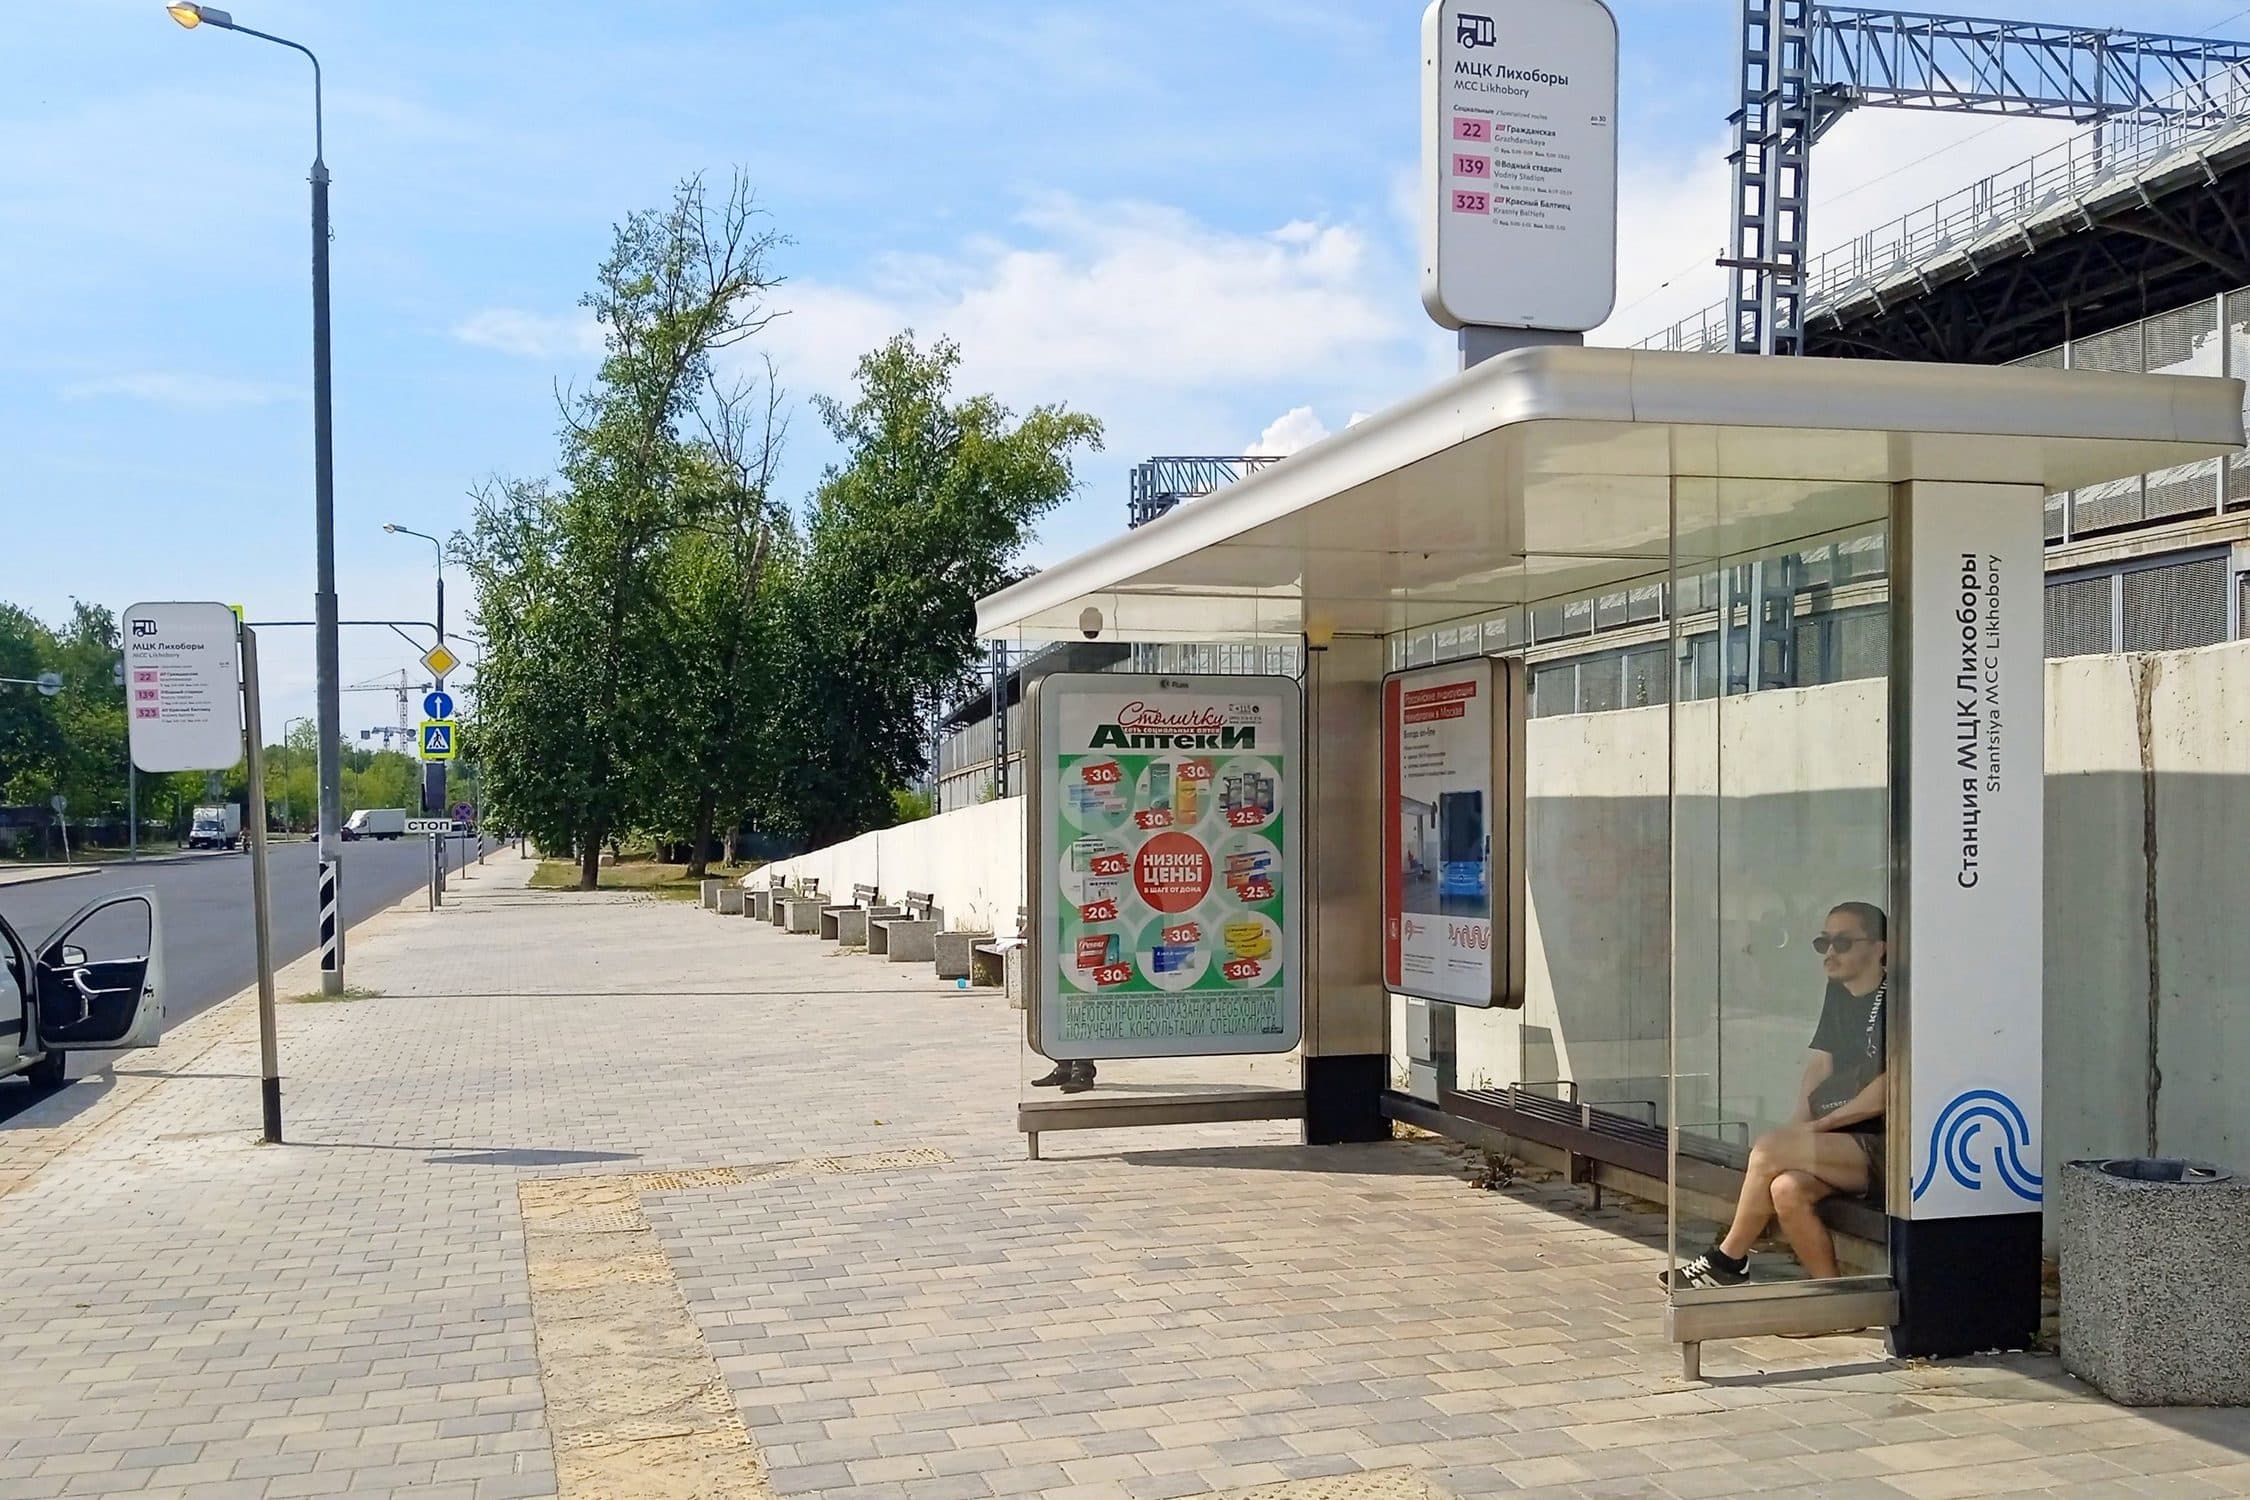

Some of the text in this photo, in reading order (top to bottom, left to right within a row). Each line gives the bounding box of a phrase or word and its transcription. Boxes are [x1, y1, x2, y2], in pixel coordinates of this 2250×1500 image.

[1454, 60, 1569, 87] МЦК Лихоборы
[1454, 80, 1529, 98] MCC Likhobory
[1462, 122, 1482, 138] 22
[1507, 125, 1556, 136] Гражданская
[1459, 159, 1484, 175] 139
[1501, 161, 1562, 173] Водный стадион
[1457, 195, 1484, 210] 323
[1505, 197, 1571, 211] Красный Балтиец
[158, 642, 204, 651] Лихоборы
[140, 673, 151, 681] 22
[1985, 554, 2003, 792] Stantsiya MCC Likhobory
[138, 691, 154, 699] 139
[1117, 701, 1228, 725] Столички
[1956, 552, 1982, 889] Станция МЦК Лихоборы
[408, 821, 449, 830] СТОП
[1143, 854, 1203, 866] НИЗКИЕ
[1143, 866, 1202, 885] ЦЕНЫ
[1066, 1004, 1113, 1022] ИМЕЮТСЯ
[1216, 999, 1277, 1018] НЕОБХОДИМО
[1066, 1021, 1124, 1039] ПОЛУЧЕНИЕ
[1131, 1019, 1205, 1037] КОНСУЛЬТАЦИИ
